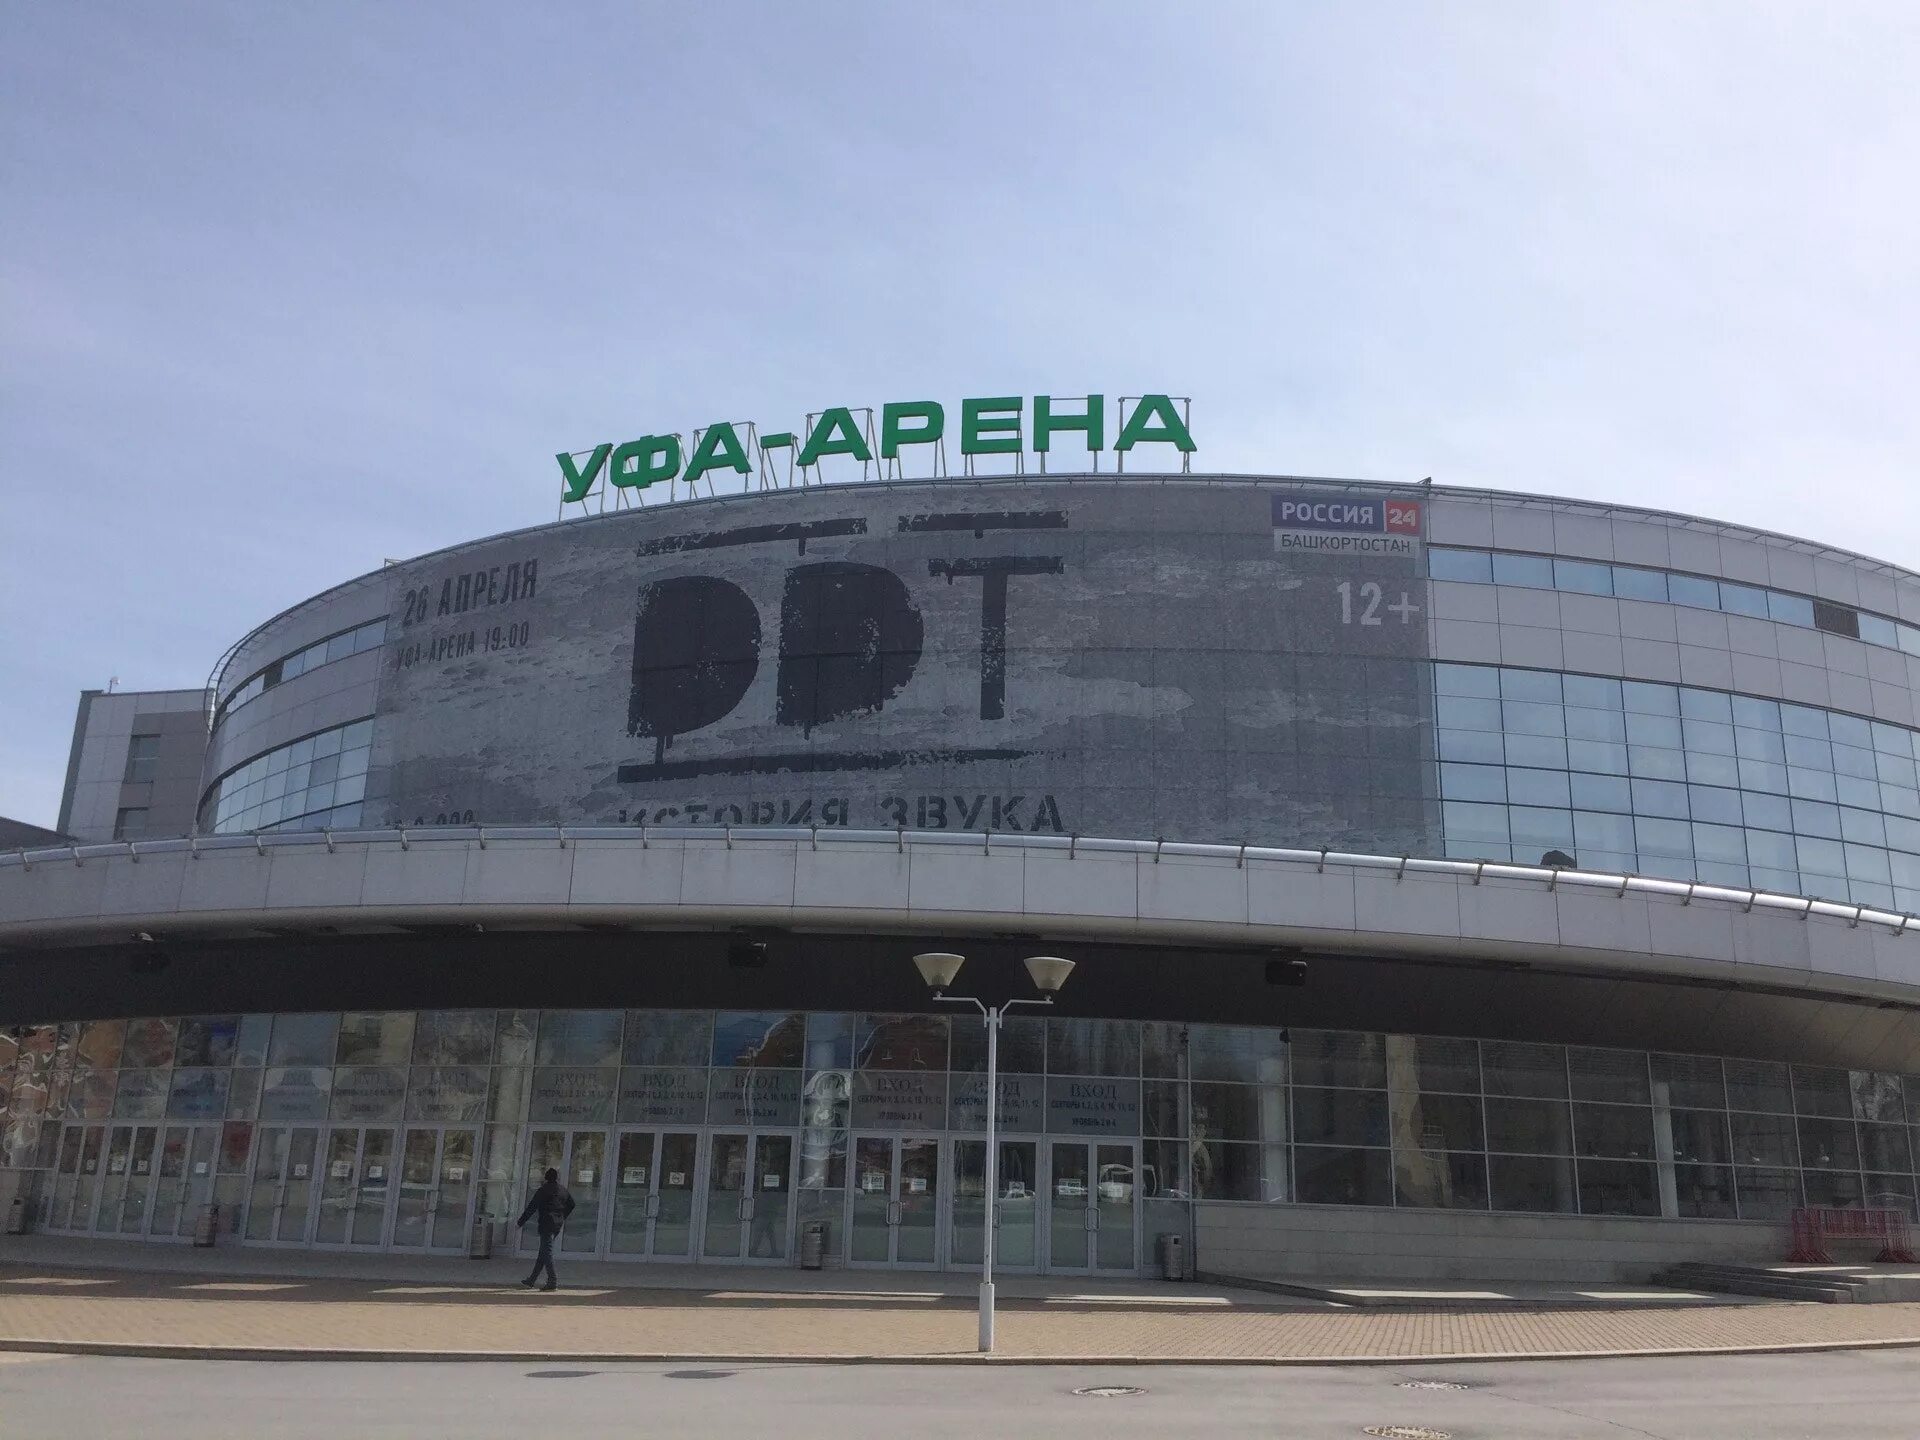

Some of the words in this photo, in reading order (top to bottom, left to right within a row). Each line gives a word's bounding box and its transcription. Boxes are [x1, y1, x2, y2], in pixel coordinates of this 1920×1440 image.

[555, 394, 1198, 503] УФА-АРЕНА
[1281, 501, 1374, 525] РОССИЯ
[1388, 508, 1416, 527] 24
[1281, 534, 1411, 553] БАШКОРТОСТАН
[402, 585, 430, 628] 26
[436, 558, 539, 617] АПРЕЛЯ
[1336, 581, 1420, 626] 12+
[396, 630, 475, 672] УФА-АРЕНА
[625, 556, 1065, 742] DDT
[880, 793, 1065, 833] ЗВУКА
[1070, 1083, 1119, 1100] ВХОД
